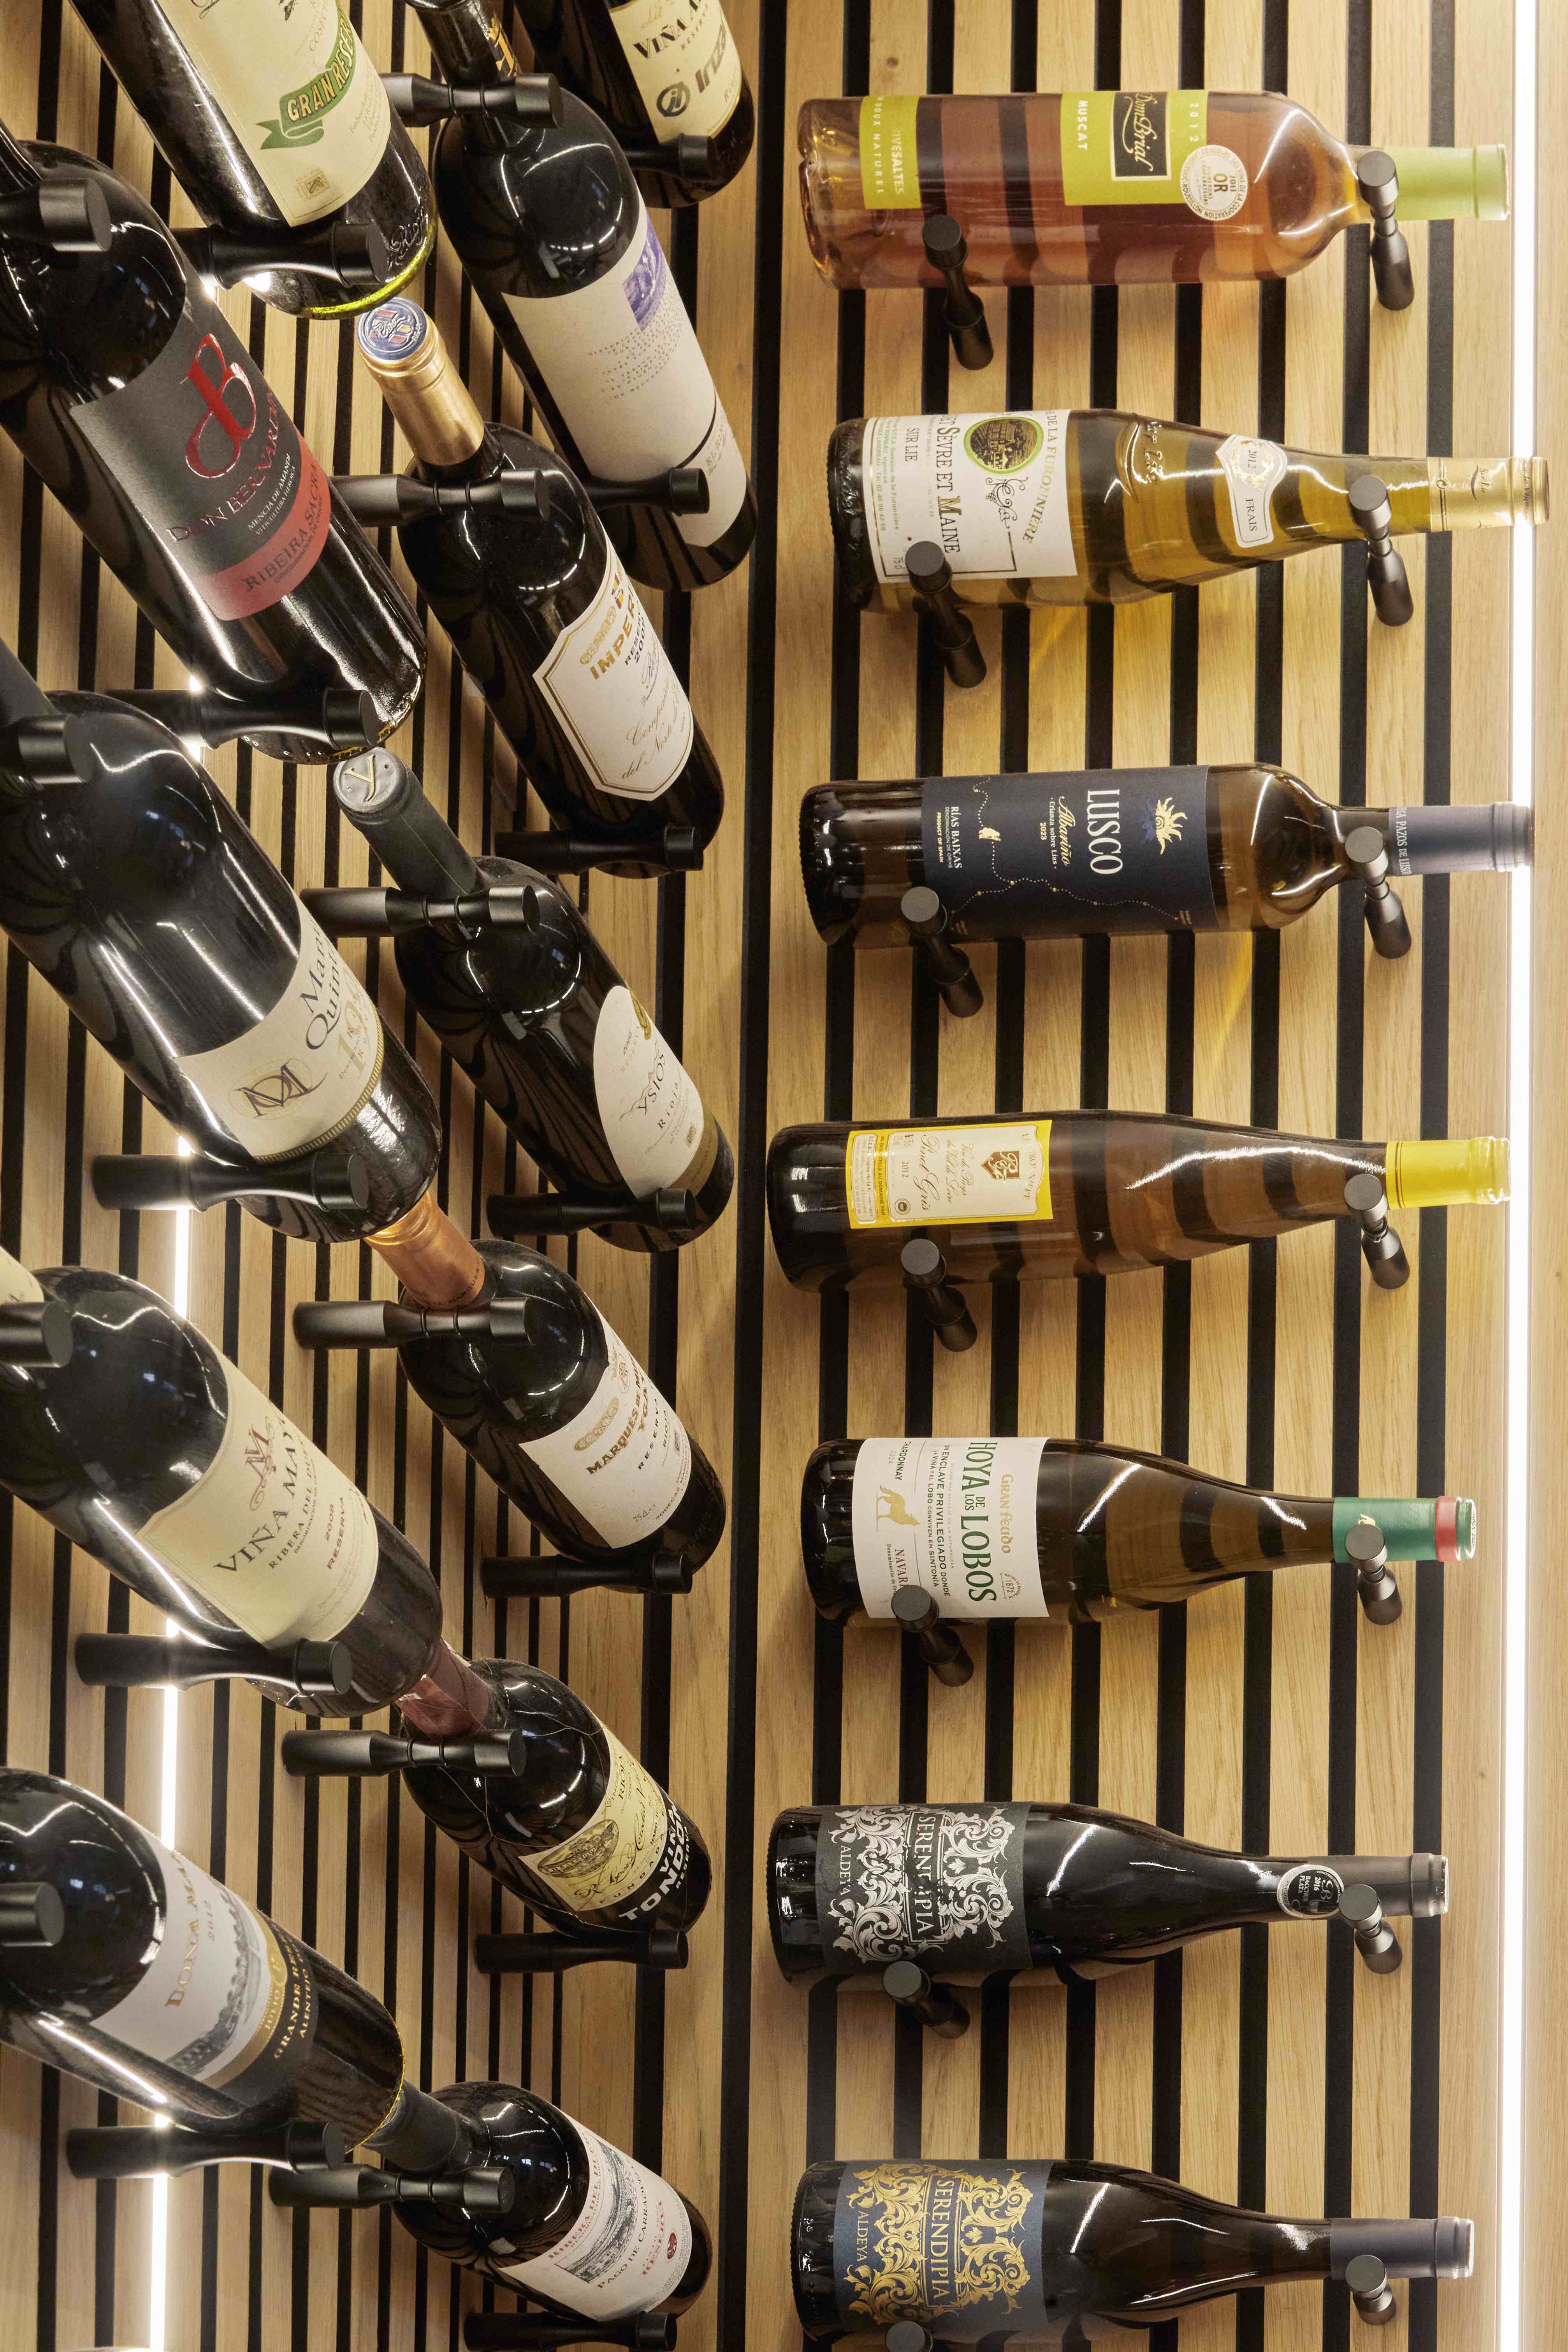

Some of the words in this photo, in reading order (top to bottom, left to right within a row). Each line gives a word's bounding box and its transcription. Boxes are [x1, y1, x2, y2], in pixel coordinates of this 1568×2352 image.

[633, 18, 688, 59] VIÑA
[287, 71, 336, 122] GRAN
[1077, 100, 1088, 150] MUSCAT
[1190, 102, 1199, 143] 2012
[873, 134, 884, 194] NATUREL
[1133, 117, 1158, 172] Brial
[1213, 173, 1229, 193] OR
[1240, 184, 1246, 194] DE
[906, 427, 920, 445] SUR
[1047, 416, 1058, 427] DE
[1047, 427, 1058, 442] LA
[905, 446, 918, 462] LIE
[936, 427, 961, 468] SÈVRE
[1247, 449, 1257, 469] 2012
[937, 472, 953, 492] ET
[1022, 446, 1058, 544] FURONNIÈRE
[937, 496, 962, 554] MAINE
[1245, 498, 1257, 532] FRAIS
[244, 527, 309, 592] RIBEIRA
[951, 806, 961, 829] RÍAS
[1058, 796, 1076, 867] Albariño
[1087, 788, 1124, 875] LUSCO
[1396, 821, 1408, 847] PAZOS
[938, 836, 943, 844] OF
[951, 830, 963, 869] BAIXAS
[1398, 848, 1408, 858] DE
[1398, 858, 1413, 876] LUSCO
[637, 1051, 666, 1115] YSIOS
[657, 1081, 679, 1130] Rioja
[919, 1134, 940, 1173] Pinot
[913, 1172, 940, 1211] Gris
[585, 1407, 640, 1475] MARQUÉS
[638, 1397, 659, 1471] RESERVA
[895, 1441, 912, 1482] CHARDONNAY
[937, 1451, 949, 1489] ENCLAVE
[961, 1442, 998, 1492] HOYA
[965, 1494, 974, 1511] LOS
[976, 1496, 986, 1508] DE
[1000, 1473, 1014, 1508] GRAN
[213, 1509, 289, 1574] VIÑA
[268, 1522, 305, 1570] RIBERA
[302, 1486, 312, 1515] DEL
[326, 1495, 346, 1570] RESERVA
[936, 1492, 947, 1570] PRIVILEGIADO
[886, 1544, 895, 1577] Denominación
[929, 1550, 939, 1588] SINTONÍA
[960, 1514, 998, 1602] LOBOS
[940, 1572, 950, 1597] DONDE
[1005, 1579, 1014, 1594] 1872
[1303, 1876, 1311, 1902] BACCHUS
[274, 1984, 301, 2059] GRANDE
[299, 1968, 311, 2039] ALENTEJO
[856, 2210, 870, 2262] ALDEYA
[930, 2180, 954, 2299] SERENDIPIA
[596, 2263, 628, 2289] PAGO
[628, 2246, 640, 2262] DE
